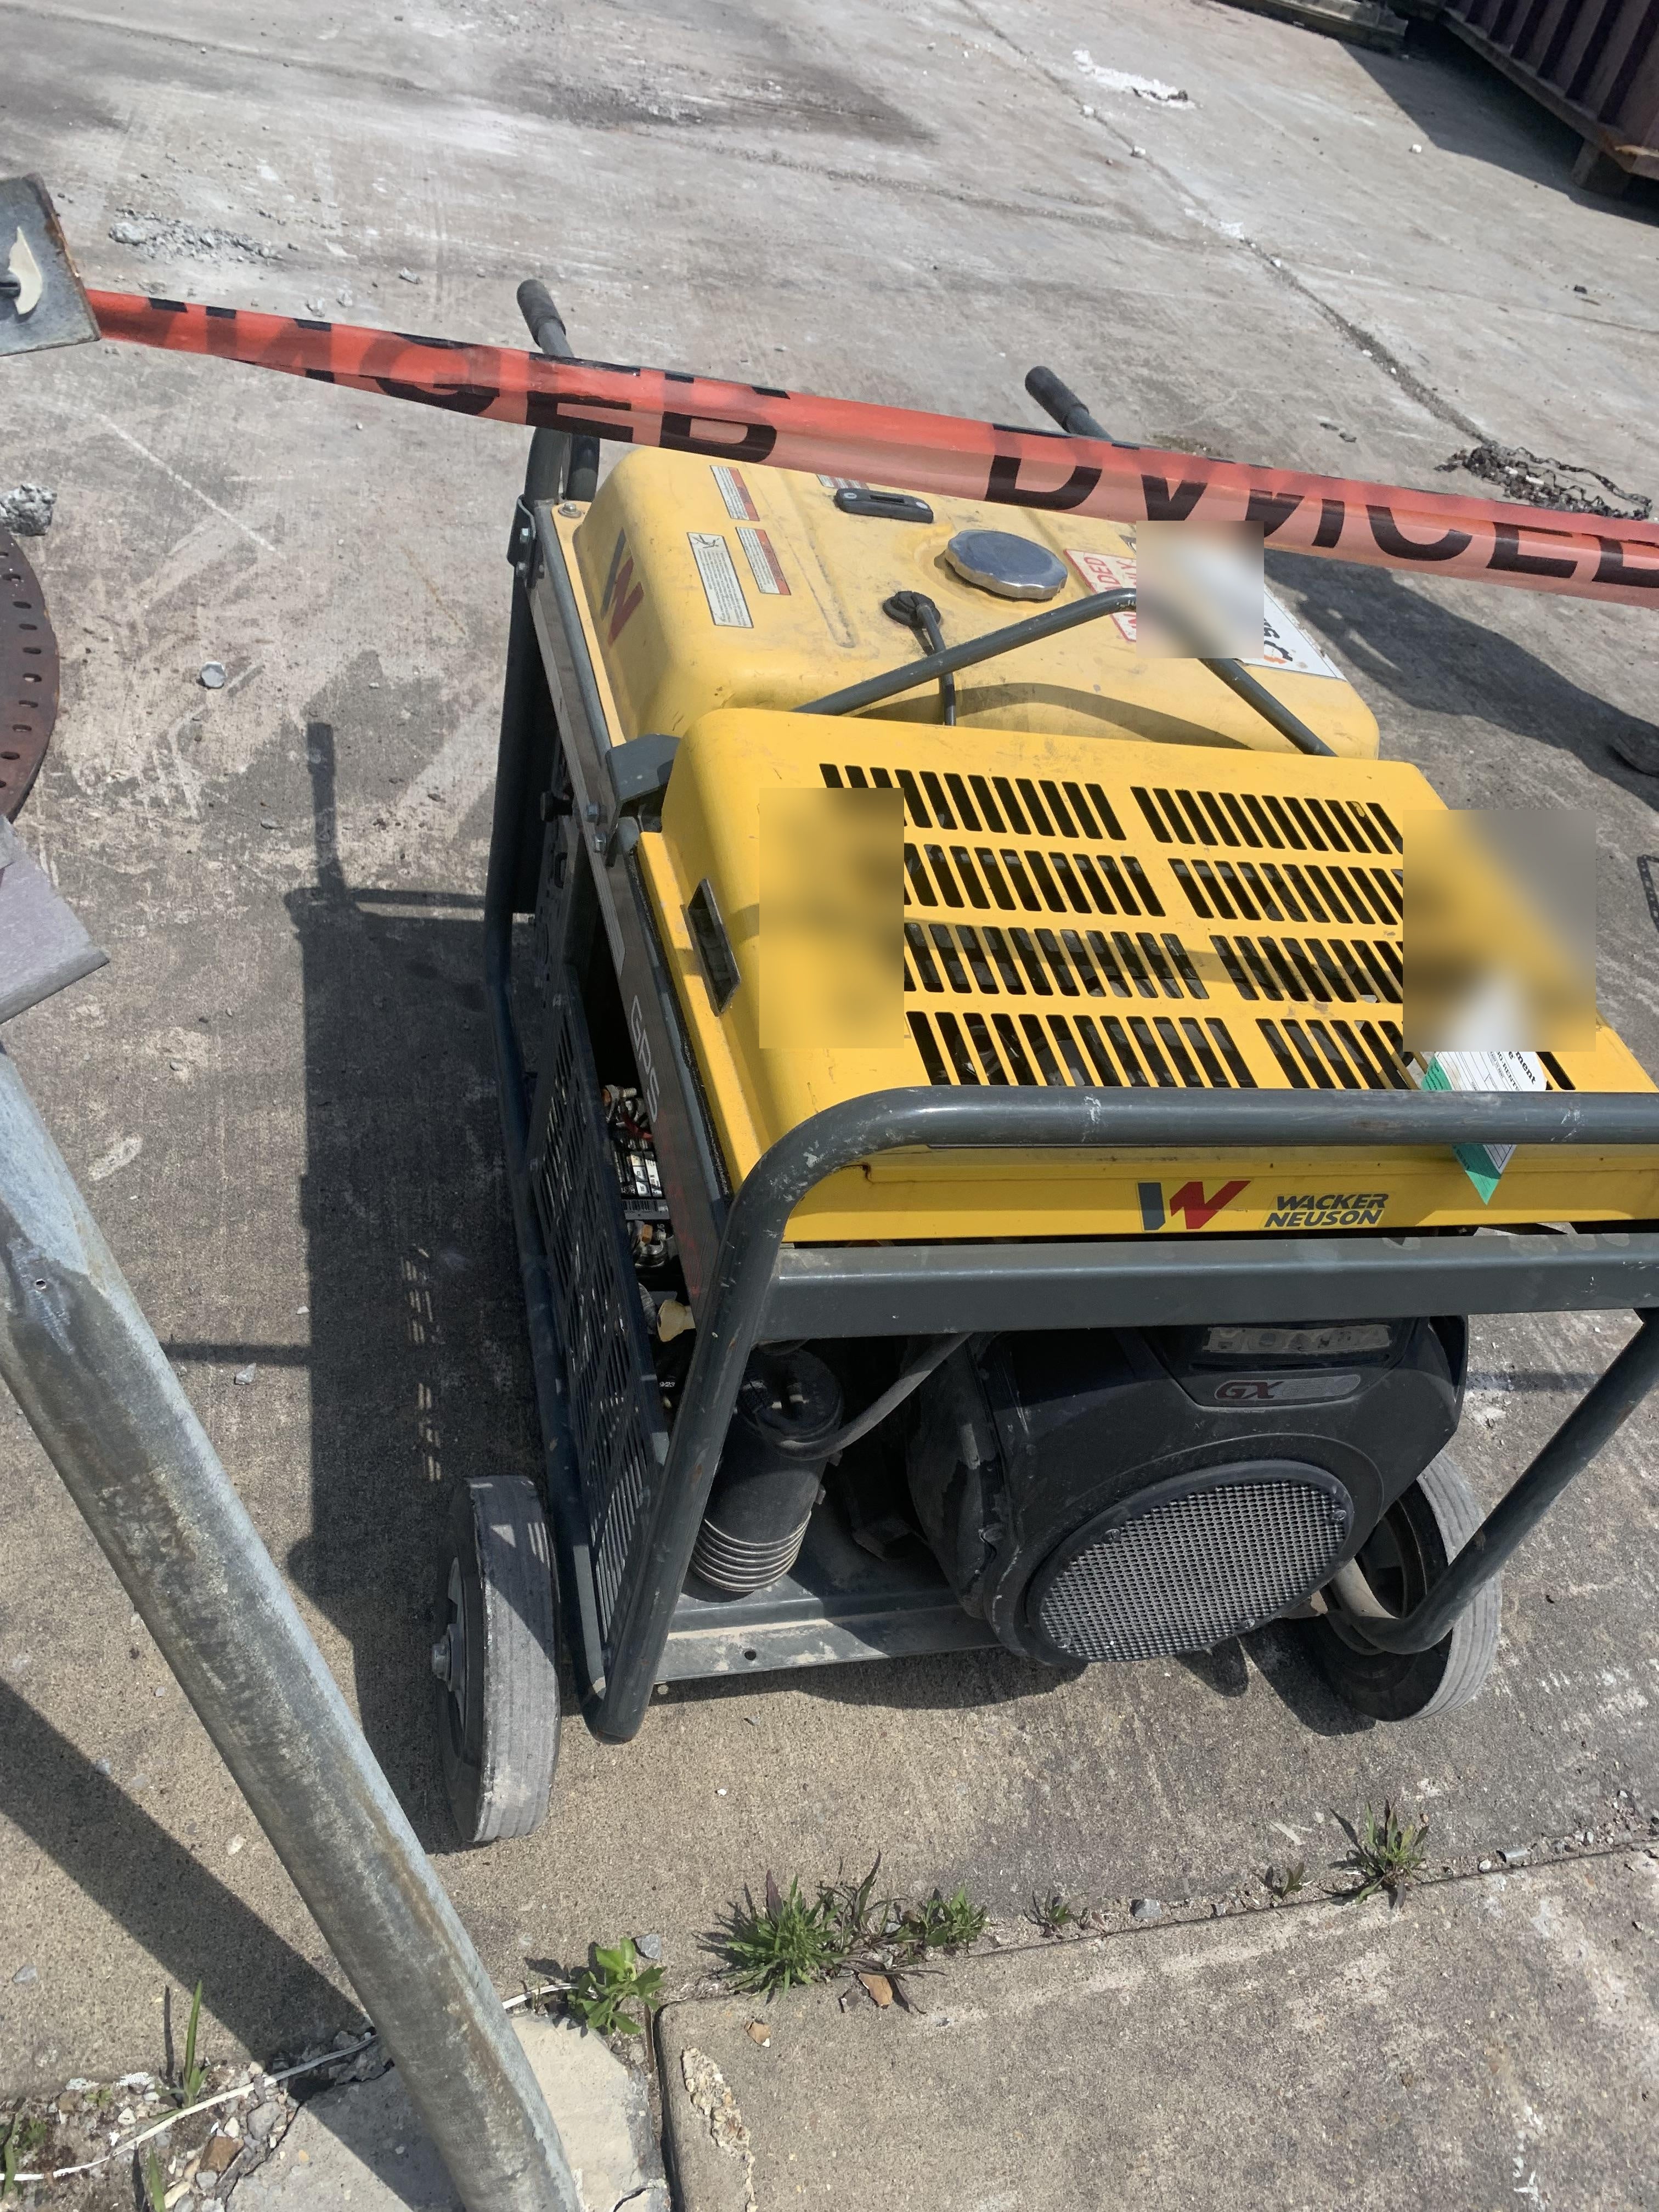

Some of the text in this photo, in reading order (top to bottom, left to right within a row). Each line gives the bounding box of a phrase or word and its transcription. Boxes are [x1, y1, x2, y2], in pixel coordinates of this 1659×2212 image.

[630, 995, 660, 1123] GPS
[1277, 1193, 1389, 1209] WACKER
[1265, 1210, 1382, 1228] NEUSON
[1215, 1379, 1284, 1400] GX
